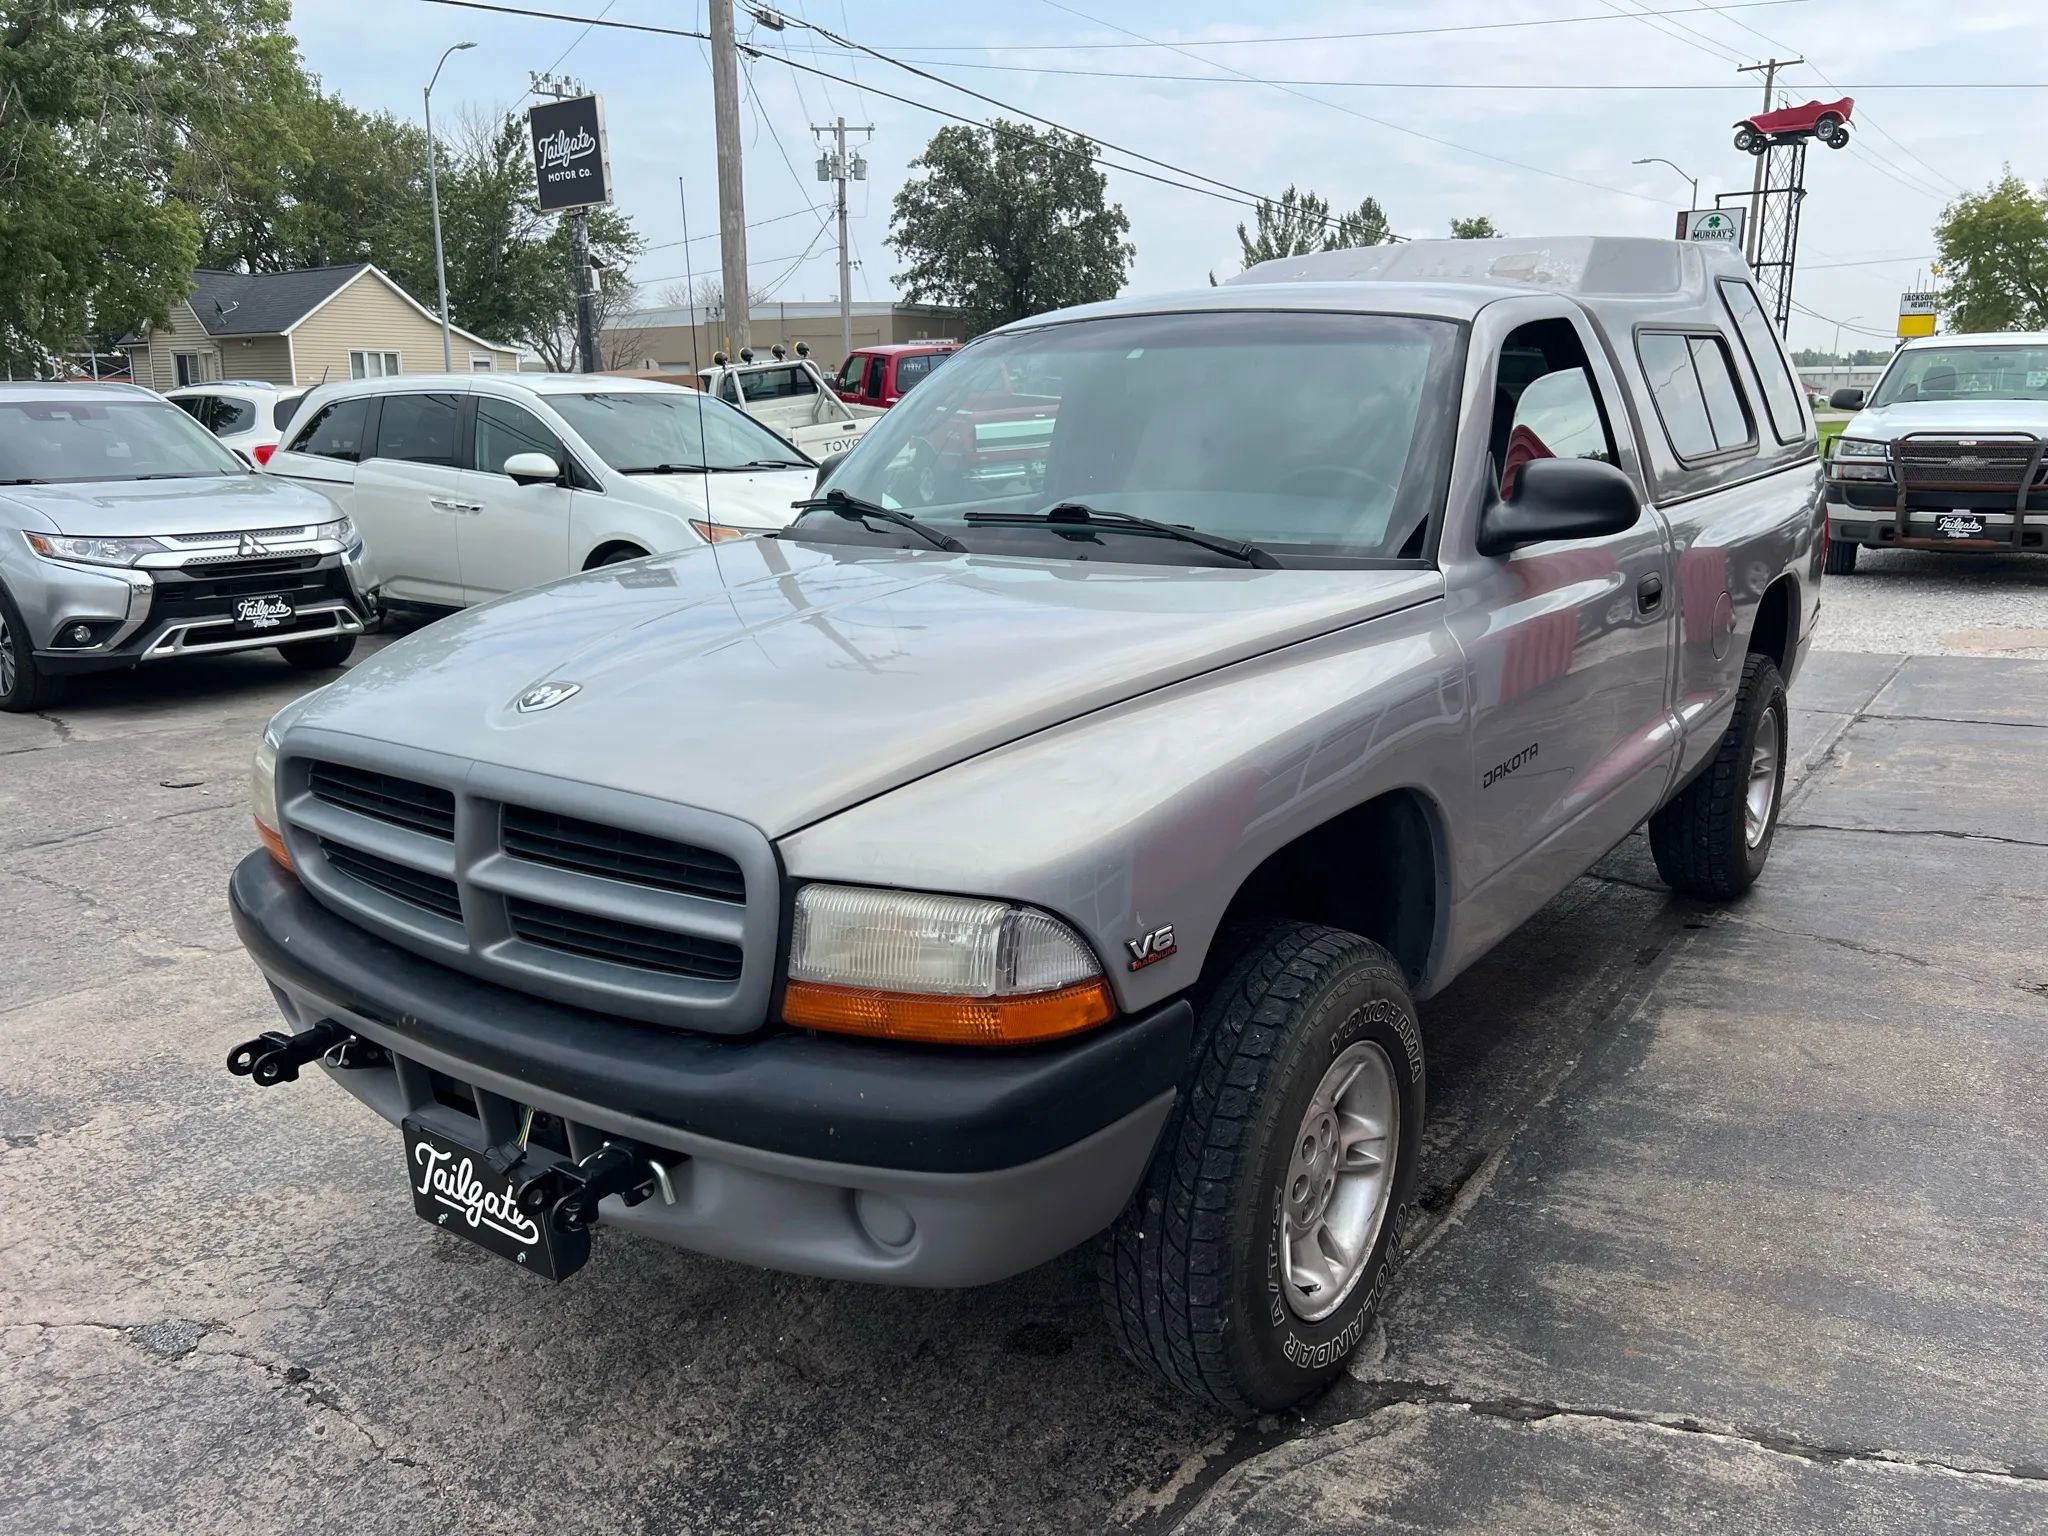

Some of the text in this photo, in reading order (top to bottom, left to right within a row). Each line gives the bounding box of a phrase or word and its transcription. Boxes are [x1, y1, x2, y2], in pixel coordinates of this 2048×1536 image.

[538, 126, 596, 169] Tailgate
[548, 168, 592, 182] MOTOR CO.
[1692, 228, 1735, 239] MURRAY'S
[1904, 294, 1934, 302] JACKSON
[1937, 517, 1982, 532] Tailgate
[238, 599, 291, 621] Tailgate
[1483, 742, 1539, 789] DAKOTA
[1127, 923, 1176, 960] V6
[1330, 998, 1423, 1084] YOKOHAMA
[1283, 1202, 1407, 1369] GEOLANDAR
